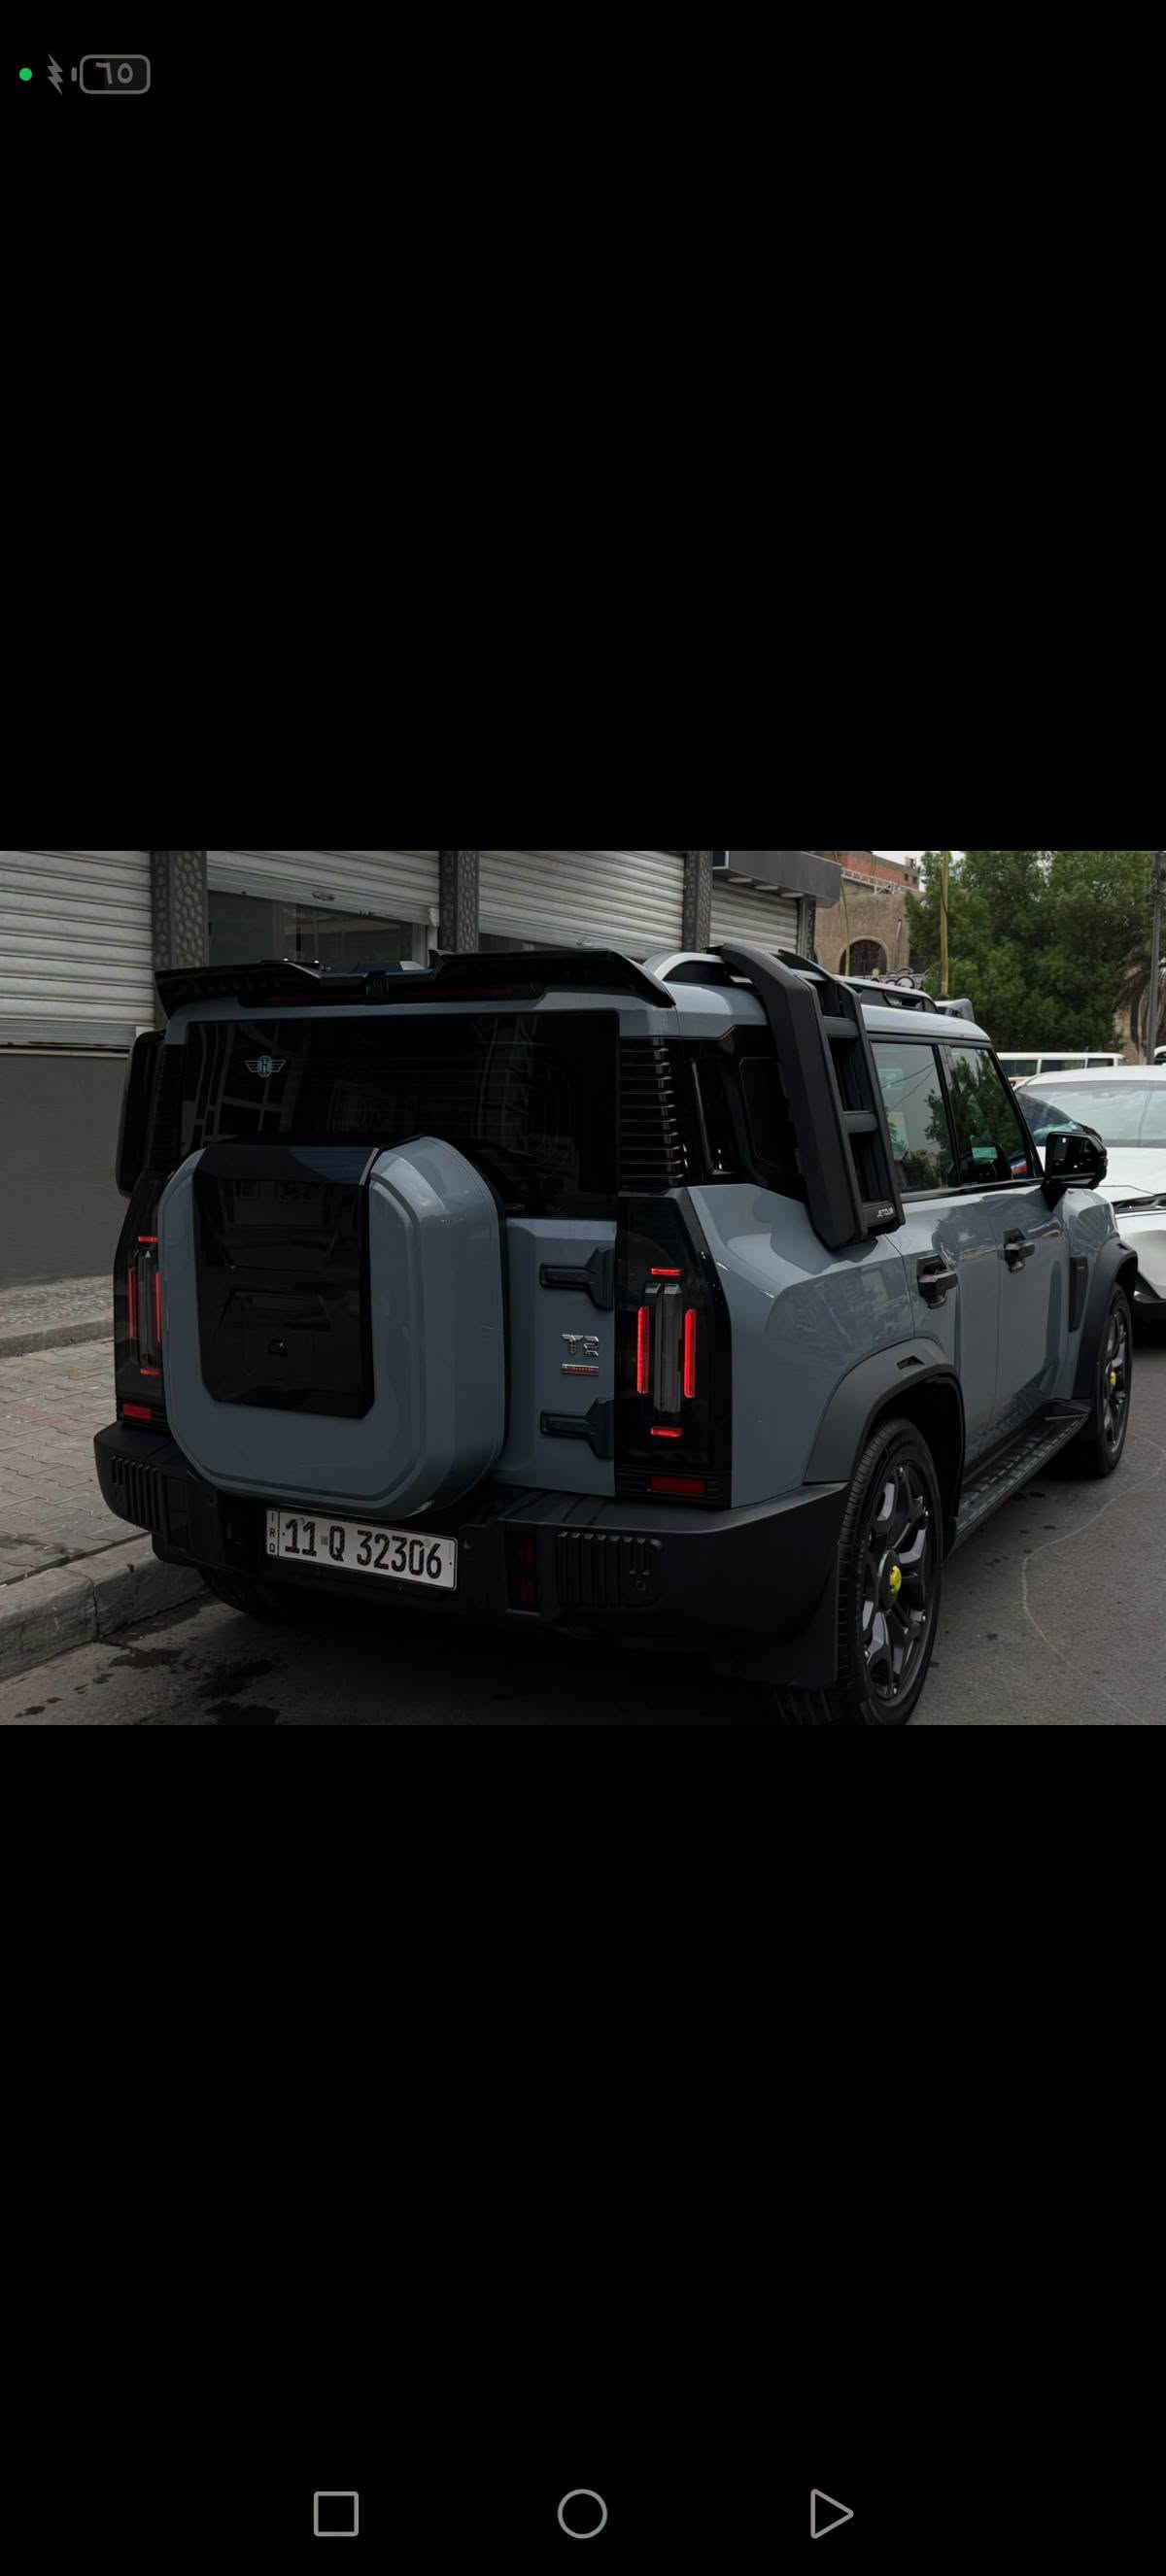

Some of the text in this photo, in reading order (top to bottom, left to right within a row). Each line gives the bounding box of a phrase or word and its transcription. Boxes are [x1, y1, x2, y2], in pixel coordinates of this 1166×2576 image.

[285, 1519, 442, 1578] 11 Q 32306
